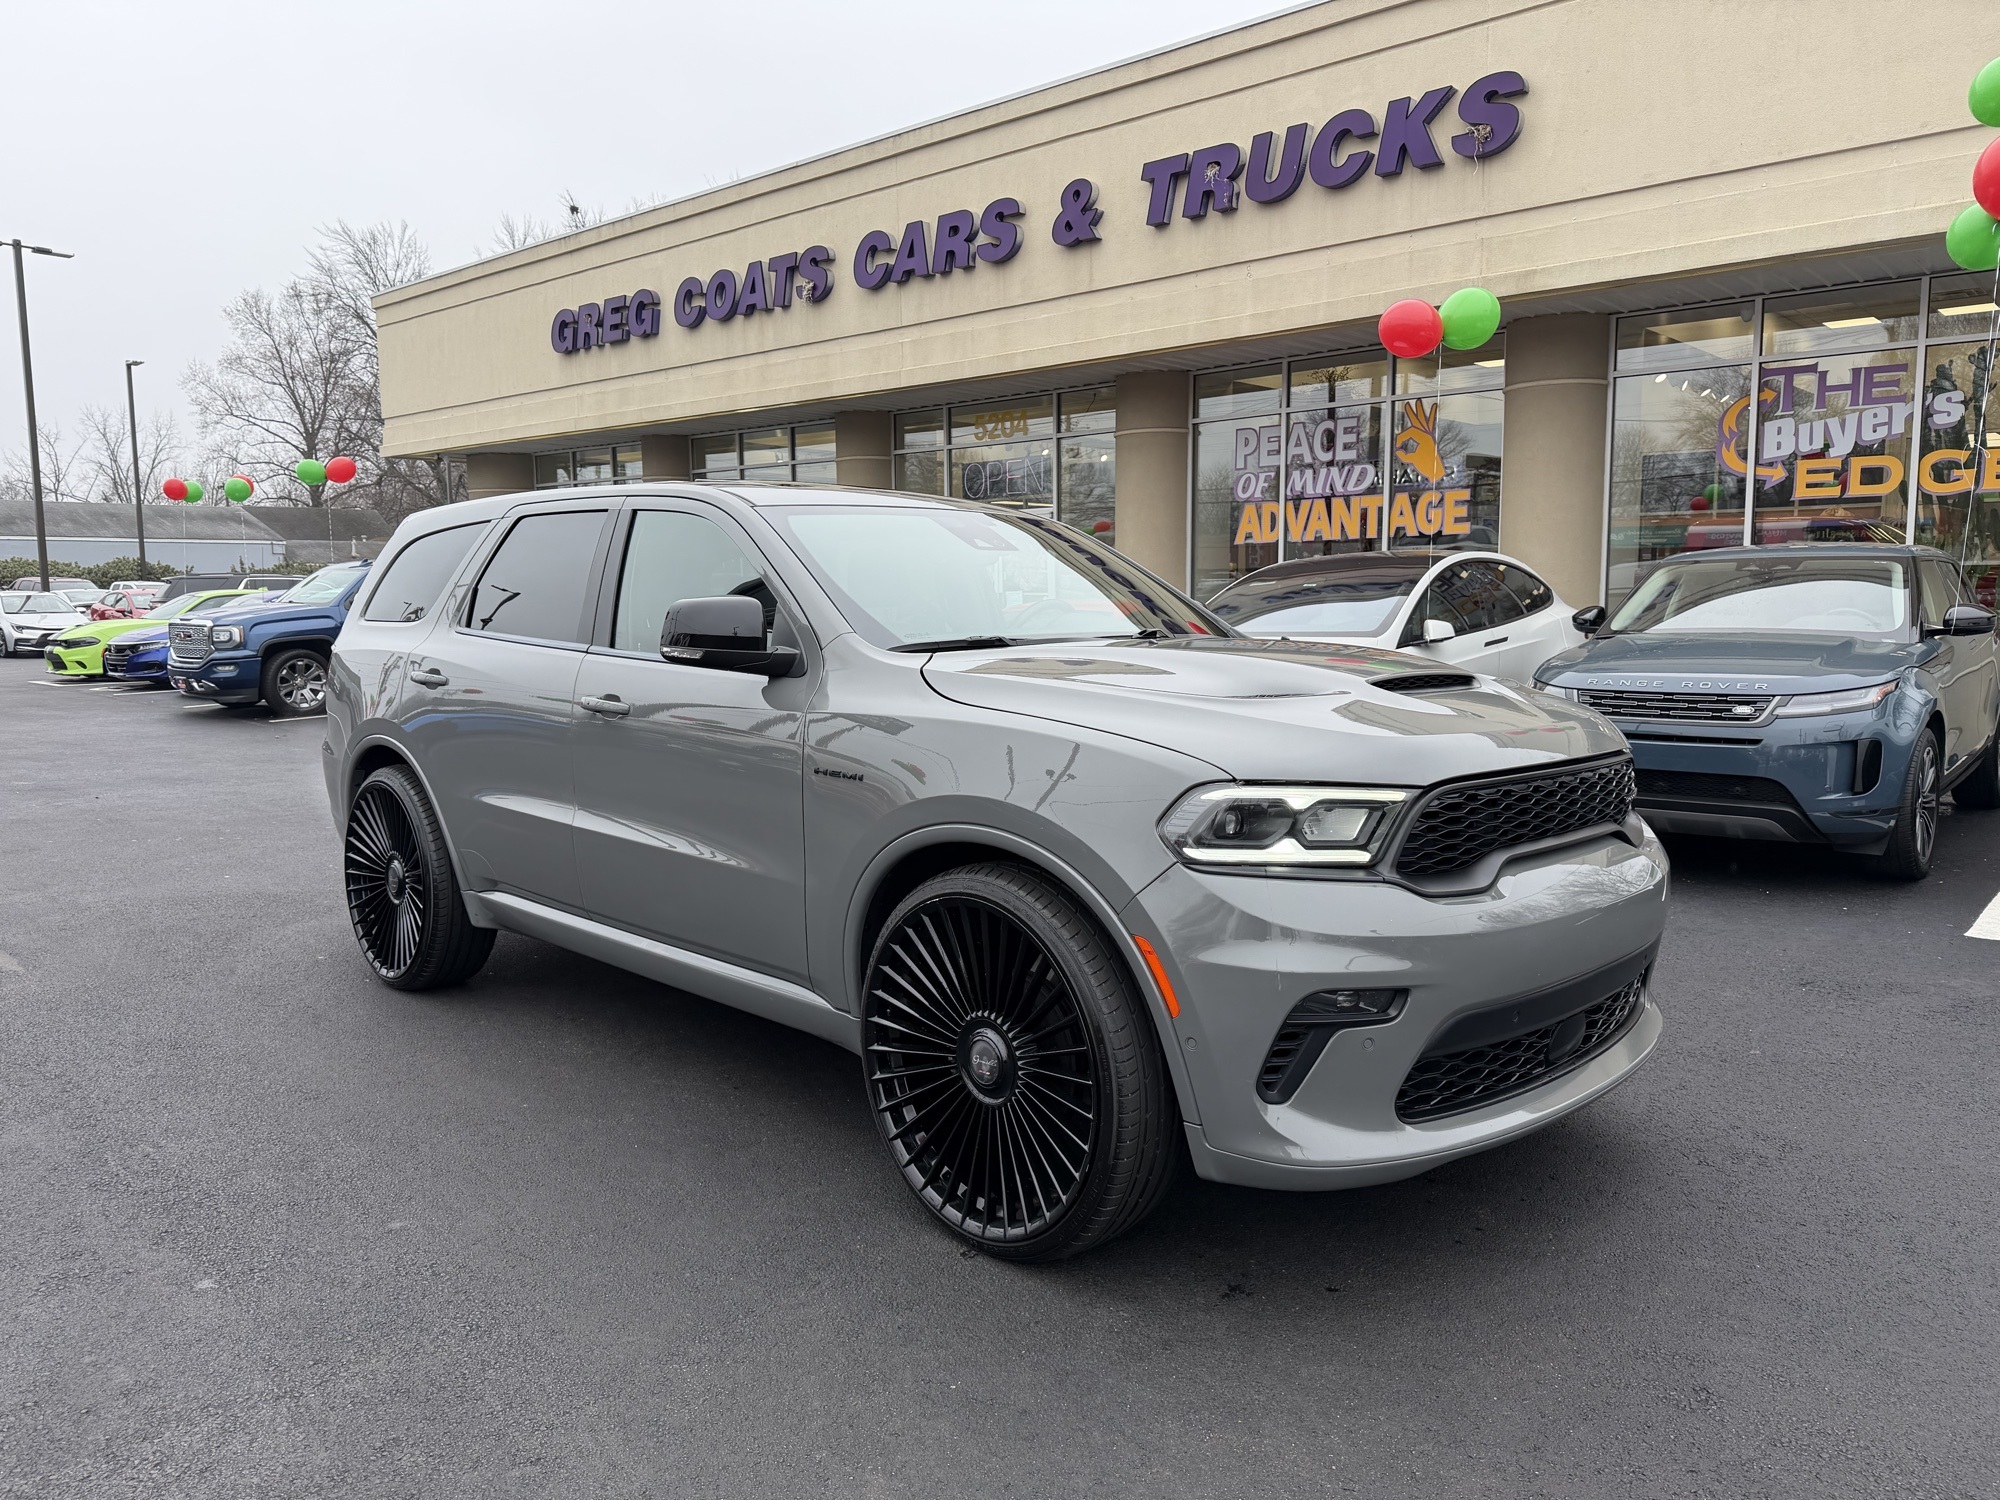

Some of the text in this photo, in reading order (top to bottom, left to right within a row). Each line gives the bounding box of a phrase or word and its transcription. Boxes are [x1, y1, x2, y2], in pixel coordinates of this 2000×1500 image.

[551, 70, 1529, 354] GREG COATS CARS & TRUCKS
[1761, 362, 1909, 416] THE
[973, 409, 1029, 441] 5204
[1234, 417, 1360, 471] PEACE
[1760, 390, 1966, 464] Buyer's
[964, 456, 1044, 498] OPEN
[1234, 470, 1275, 502] OF
[1285, 464, 1376, 501] MIND
[1234, 488, 1471, 546] ADVANTAGE
[1587, 678, 1768, 691] RANGE ROVER
[813, 767, 864, 781] HEMI
